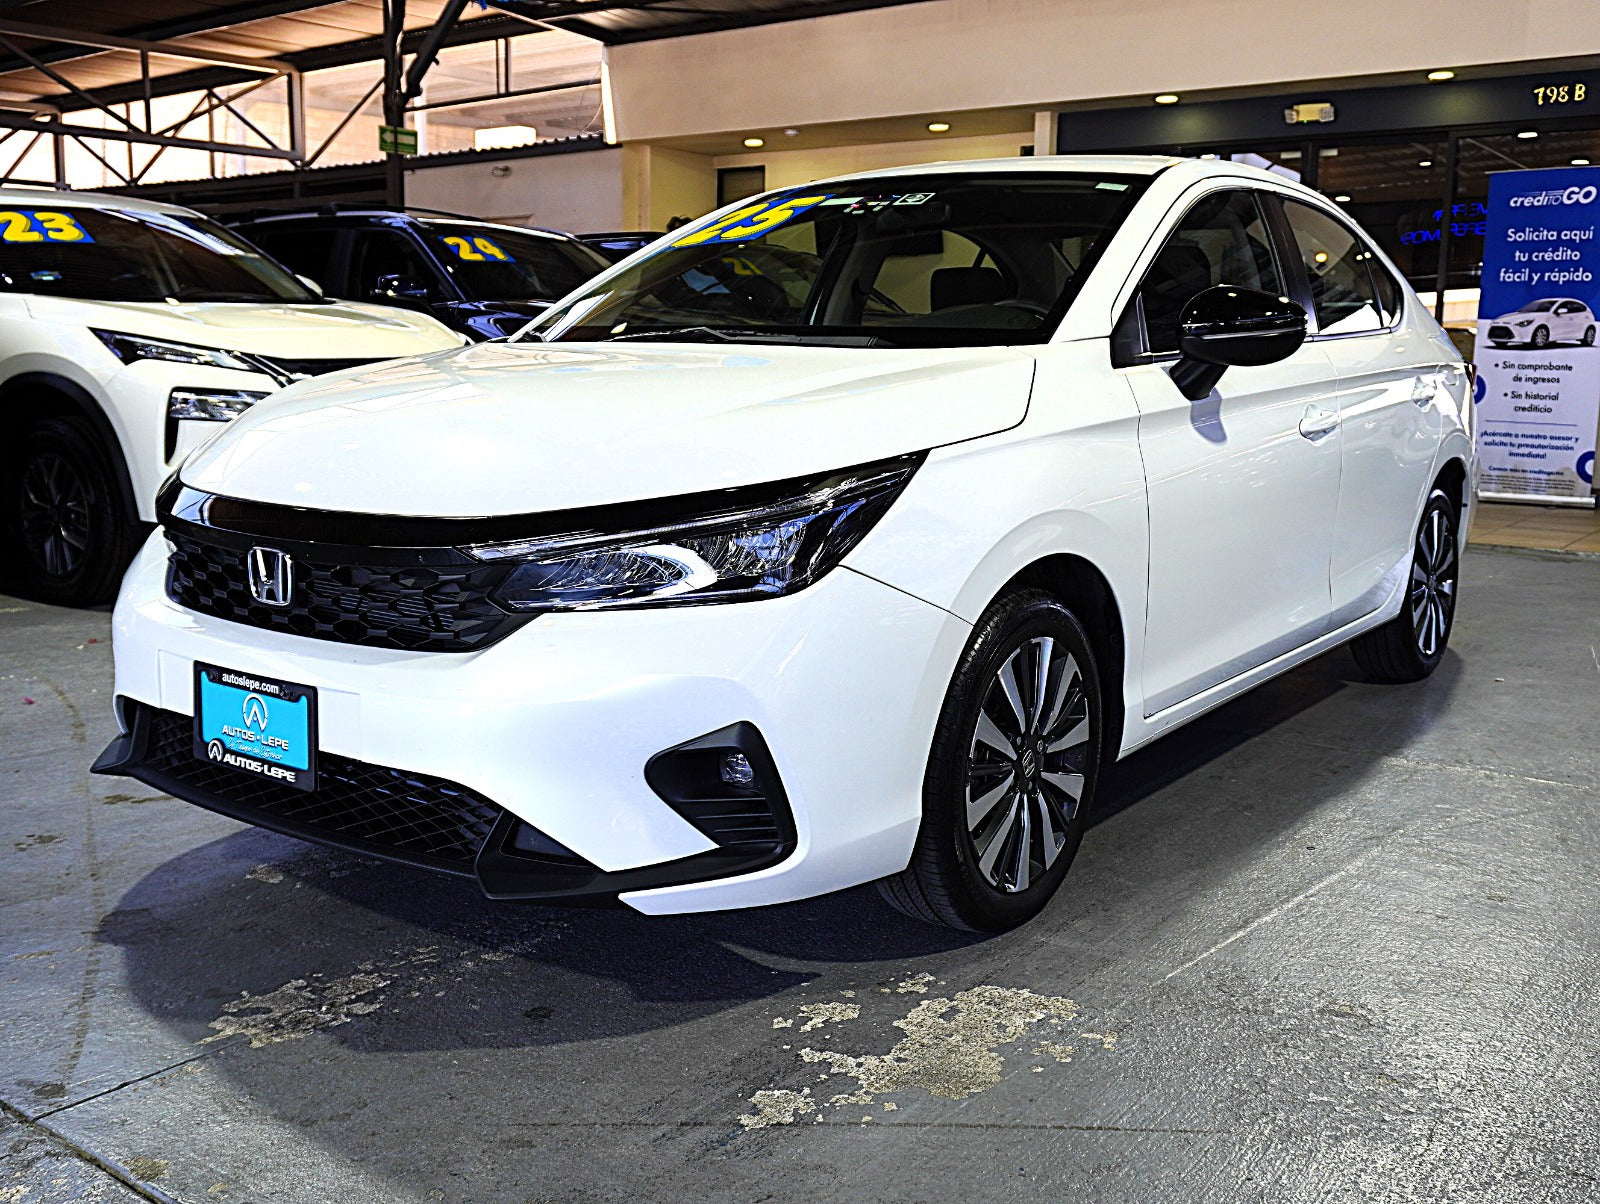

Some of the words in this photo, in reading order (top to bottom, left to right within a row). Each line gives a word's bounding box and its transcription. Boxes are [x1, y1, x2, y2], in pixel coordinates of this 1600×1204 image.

[1533, 85, 1569, 106] 798
[1574, 83, 1586, 101] B
[0, 211, 85, 242] 23
[671, 195, 826, 248] 25
[1507, 227, 1558, 242] Solicita
[1561, 226, 1595, 243] aquí
[1515, 250, 1529, 262] tu
[1532, 246, 1581, 262] crédito
[1500, 267, 1529, 282] fácil
[1531, 272, 1541, 286] y
[1544, 266, 1593, 285] rápido
[1502, 360, 1516, 370] Sin
[1517, 361, 1573, 372] comprobante
[1512, 373, 1523, 382] de
[1525, 374, 1561, 385] ingresos
[1511, 390, 1523, 399] Sin
[1525, 390, 1560, 401] historial
[1514, 403, 1553, 413] crediticio
[221, 672, 279, 694] autoslepe.com
[221, 724, 255, 743] AUTOS
[261, 734, 289, 751] LEPE
